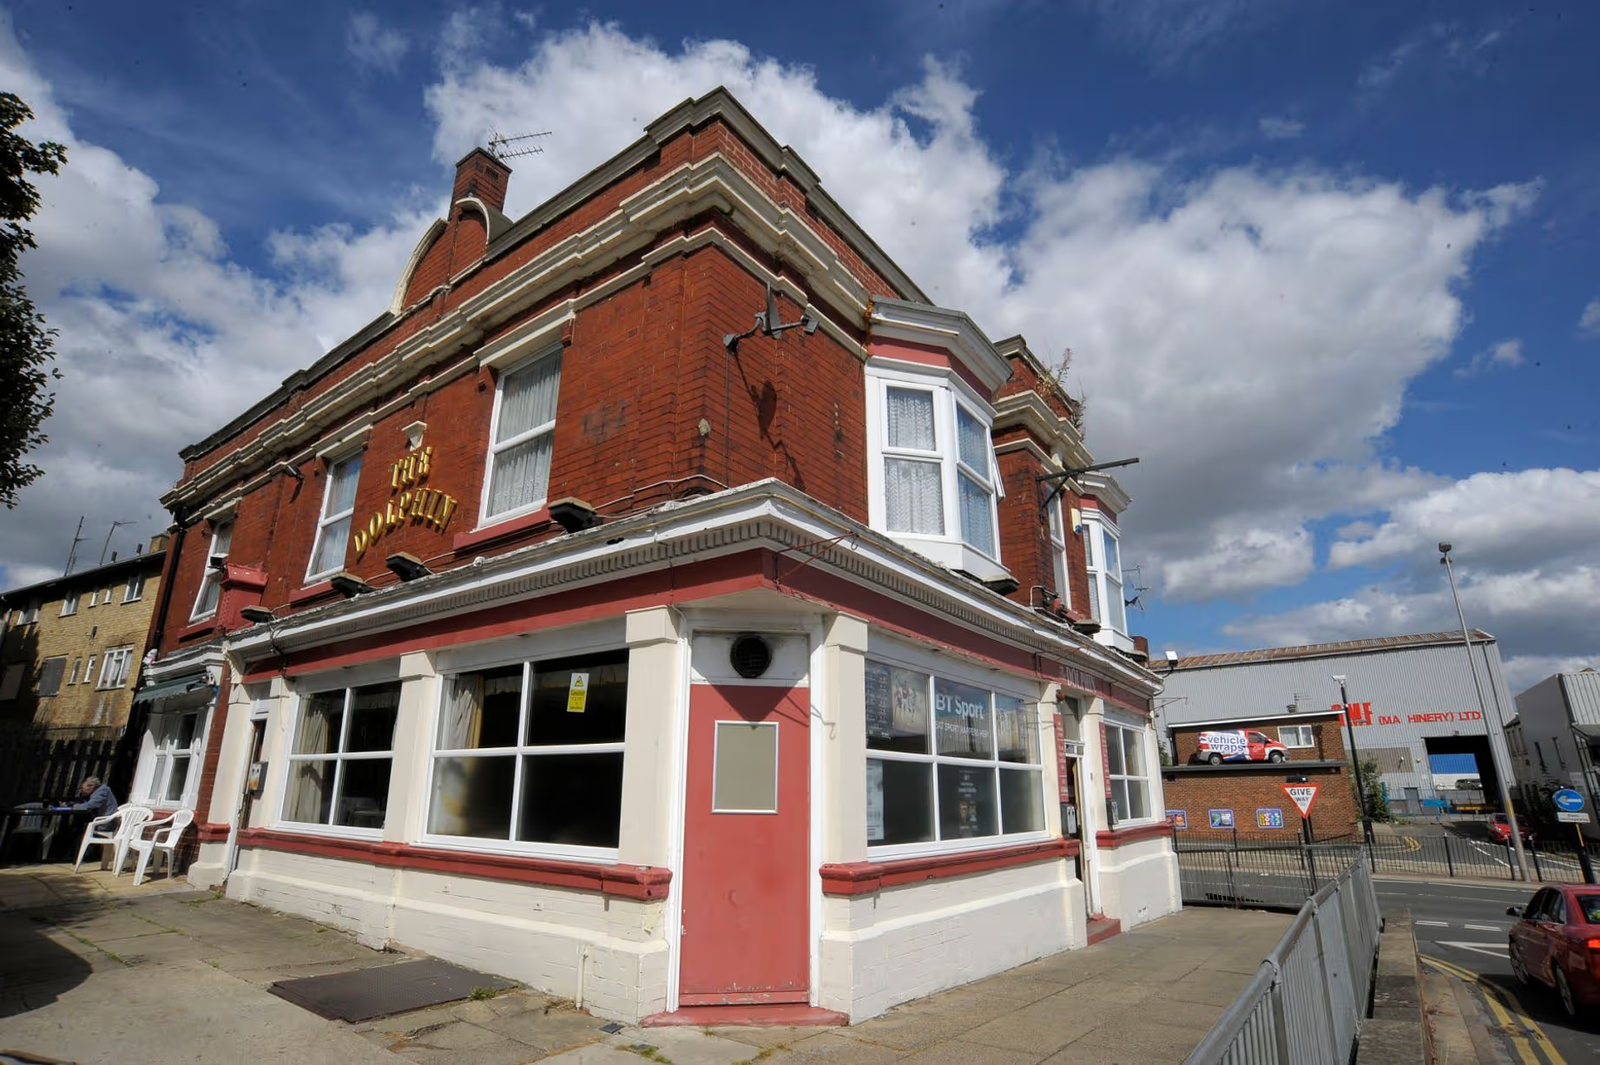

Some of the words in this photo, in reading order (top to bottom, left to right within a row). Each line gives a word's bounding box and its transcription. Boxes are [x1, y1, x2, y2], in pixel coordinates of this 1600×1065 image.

[391, 446, 432, 486] THE
[354, 487, 458, 553] DOLPHIN
[935, 693, 952, 713] BT
[955, 695, 984, 720] Sport
[1459, 710, 1481, 721] LTD
[1208, 735, 1246, 745] vehicle
[1211, 743, 1244, 752] wraps
[1290, 788, 1312, 796] GIVE
